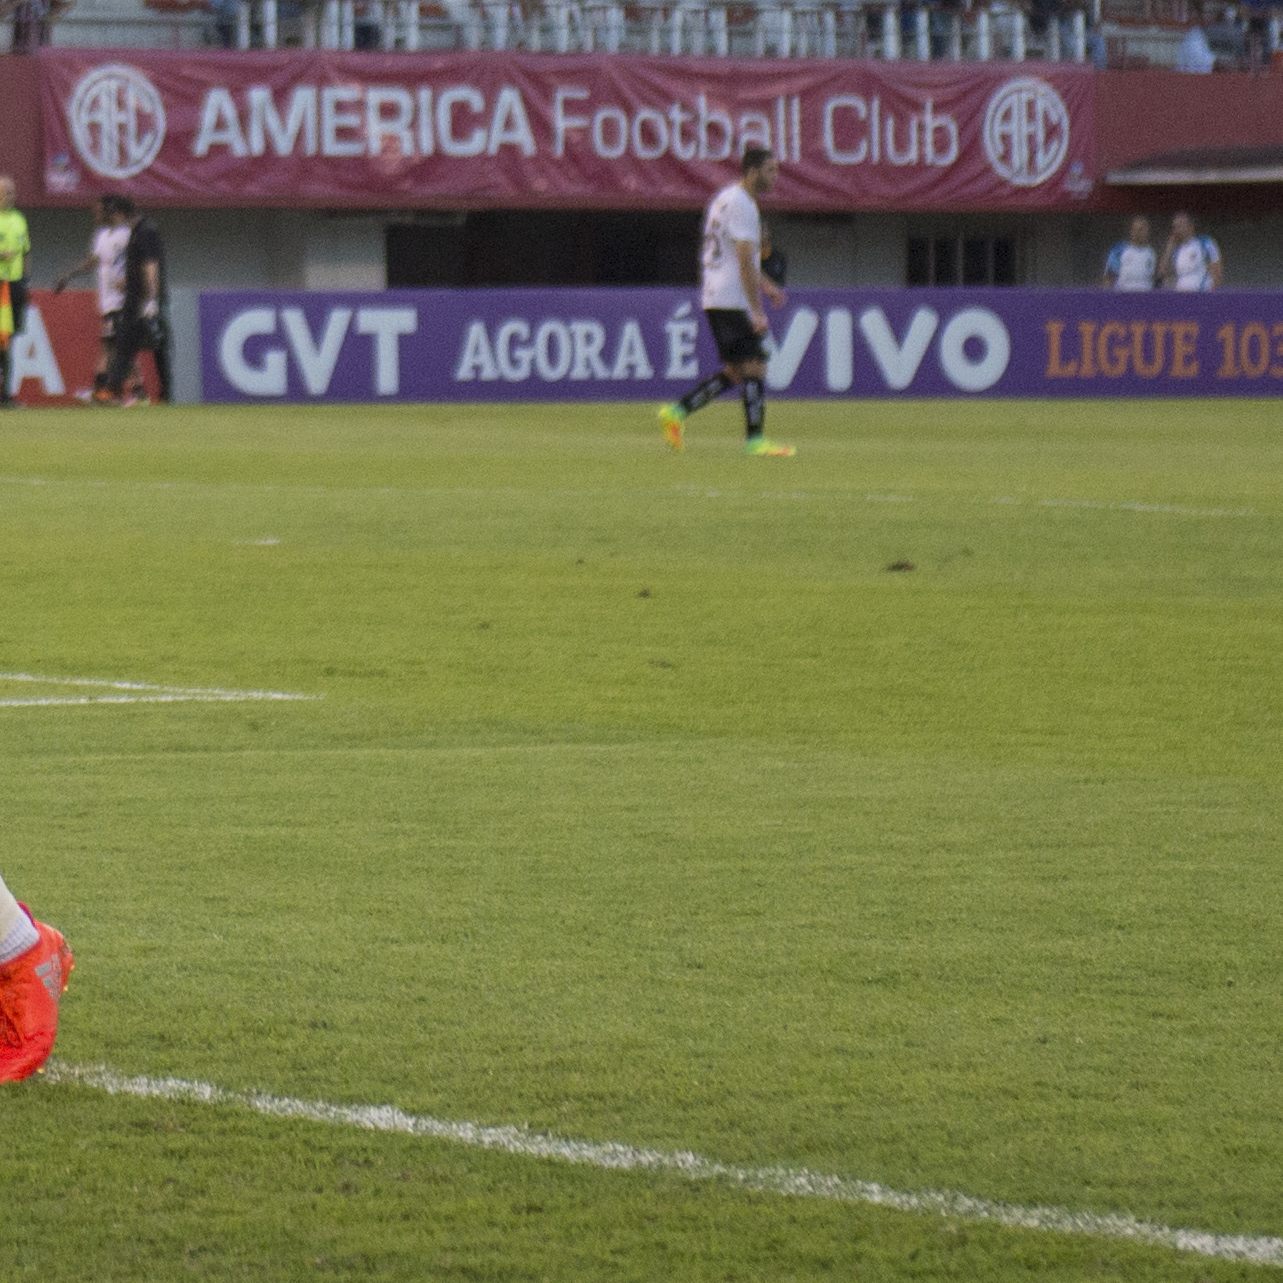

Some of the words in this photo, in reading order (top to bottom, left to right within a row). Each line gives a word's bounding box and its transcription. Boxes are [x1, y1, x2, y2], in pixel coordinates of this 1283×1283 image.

[194, 84, 535, 158] AMERICA
[552, 85, 801, 164] Football
[823, 95, 959, 166] Club
[220, 307, 418, 396] GVT
[455, 318, 655, 382] AGORA
[664, 301, 700, 381] É
[762, 306, 1011, 393] VIVO
[1044, 319, 1200, 379] LIGUE
